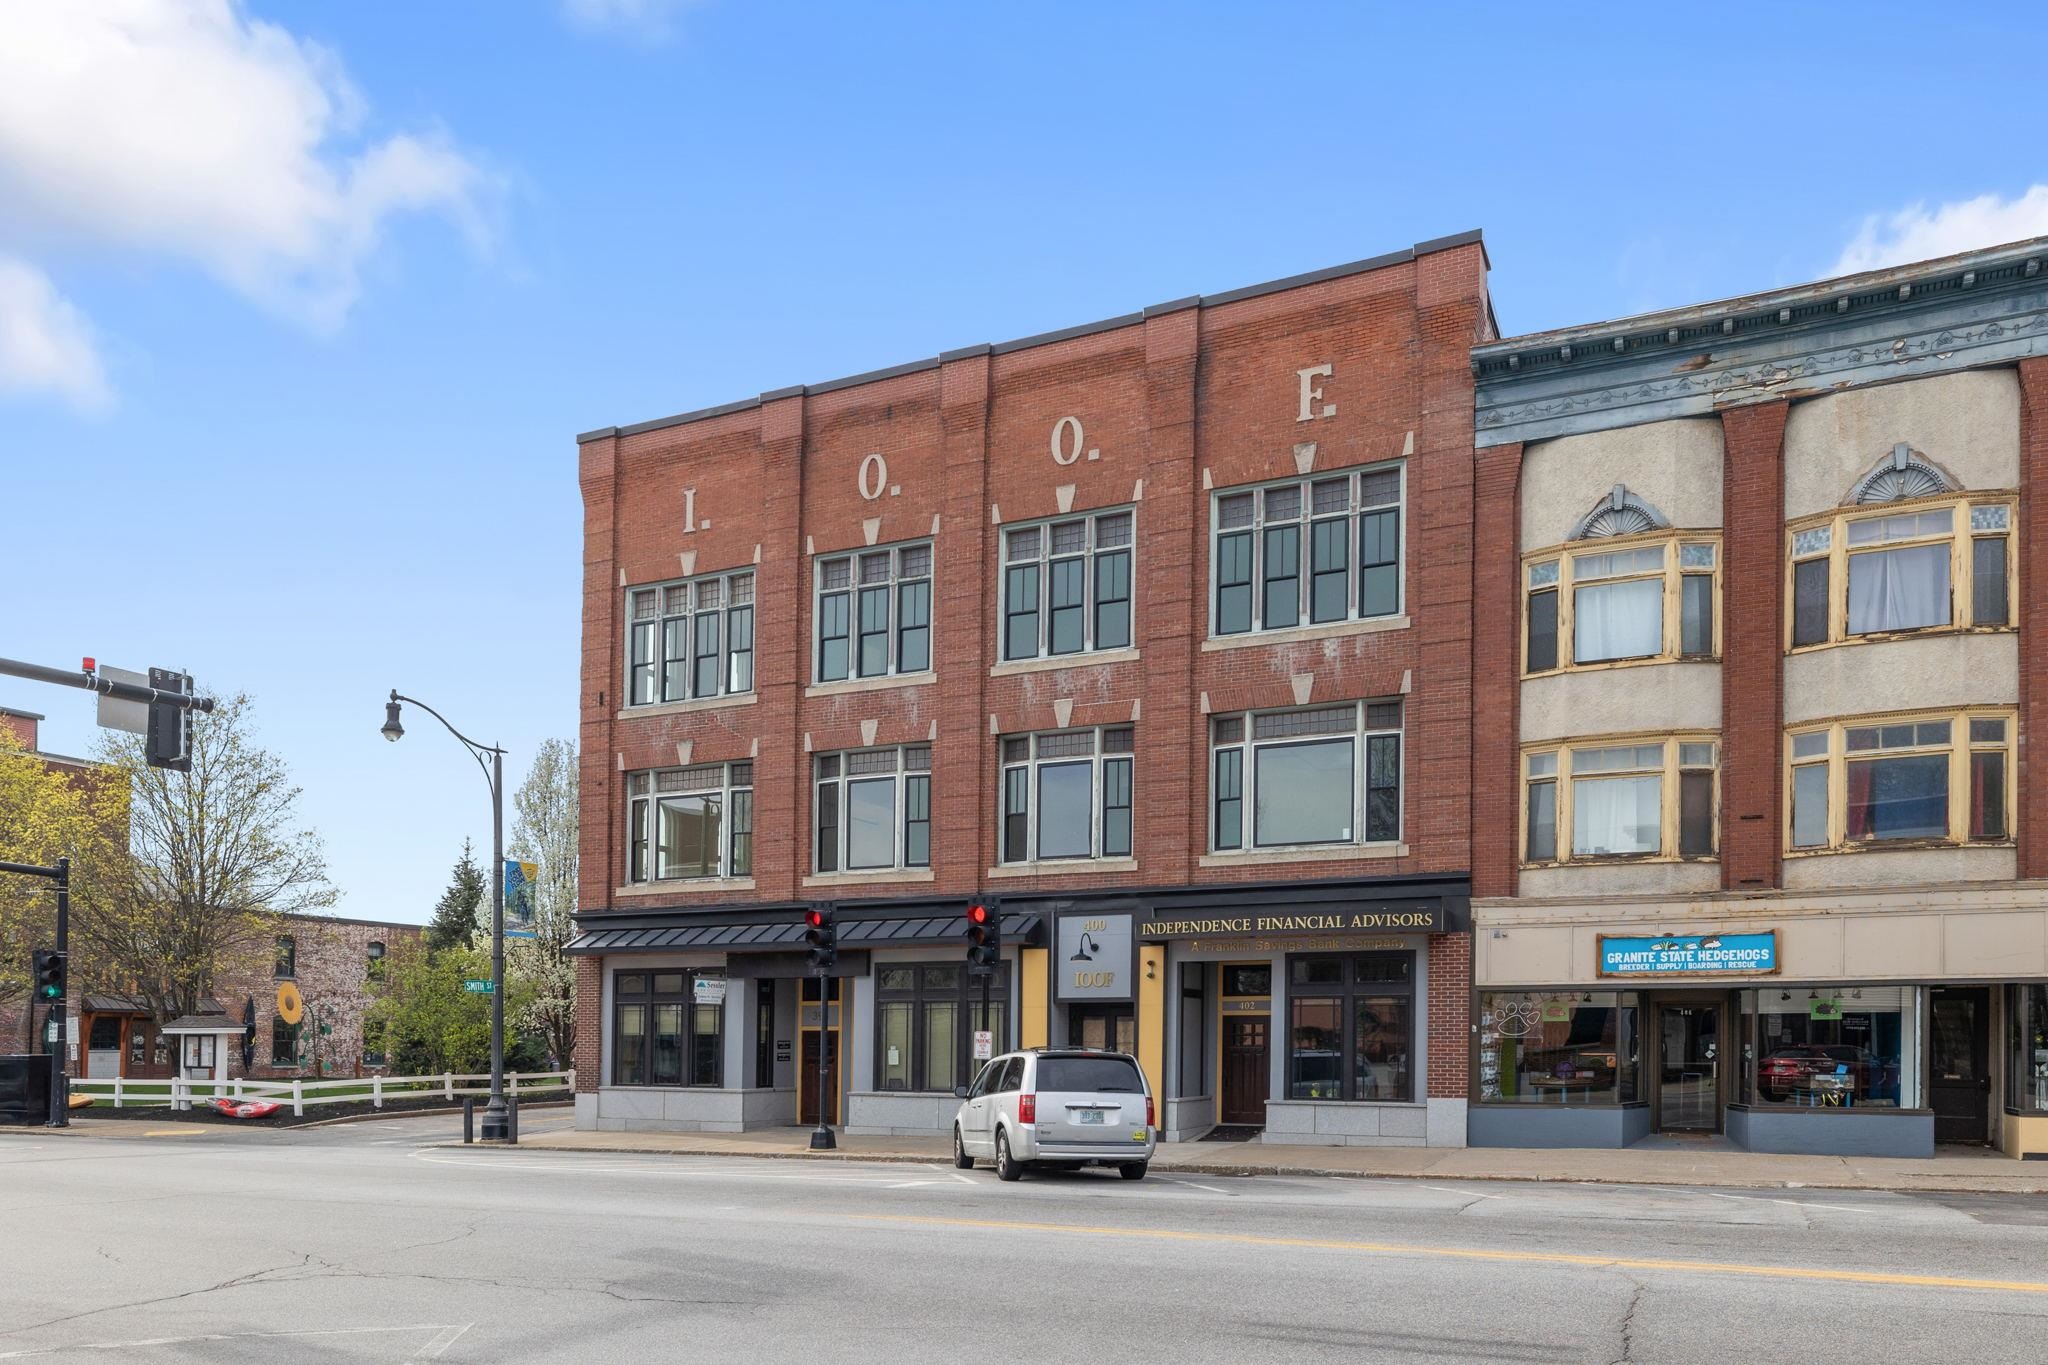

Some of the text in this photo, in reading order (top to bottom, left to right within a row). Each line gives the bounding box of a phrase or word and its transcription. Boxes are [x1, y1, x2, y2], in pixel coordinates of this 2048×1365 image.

[683, 363, 1336, 533] I. O. O. F.
[1083, 920, 1107, 931] 400
[1142, 913, 1433, 935] INDEPENDENCE FINANCIAL ADVISORS
[1191, 941, 1199, 952] A
[1204, 940, 1250, 952] Franklin
[1255, 939, 1303, 952] Savings
[1308, 938, 1339, 949] Bank
[1607, 949, 1770, 964] GRANITE STATE HEDGEHOGS
[1618, 960, 1757, 971] BREEDER SUPPLY BOARDING RESCUE
[707, 981, 725, 989] Sessler
[1074, 971, 1115, 988] IOOF
[466, 981, 484, 991] SMITH
[1240, 1001, 1256, 1010] 402
